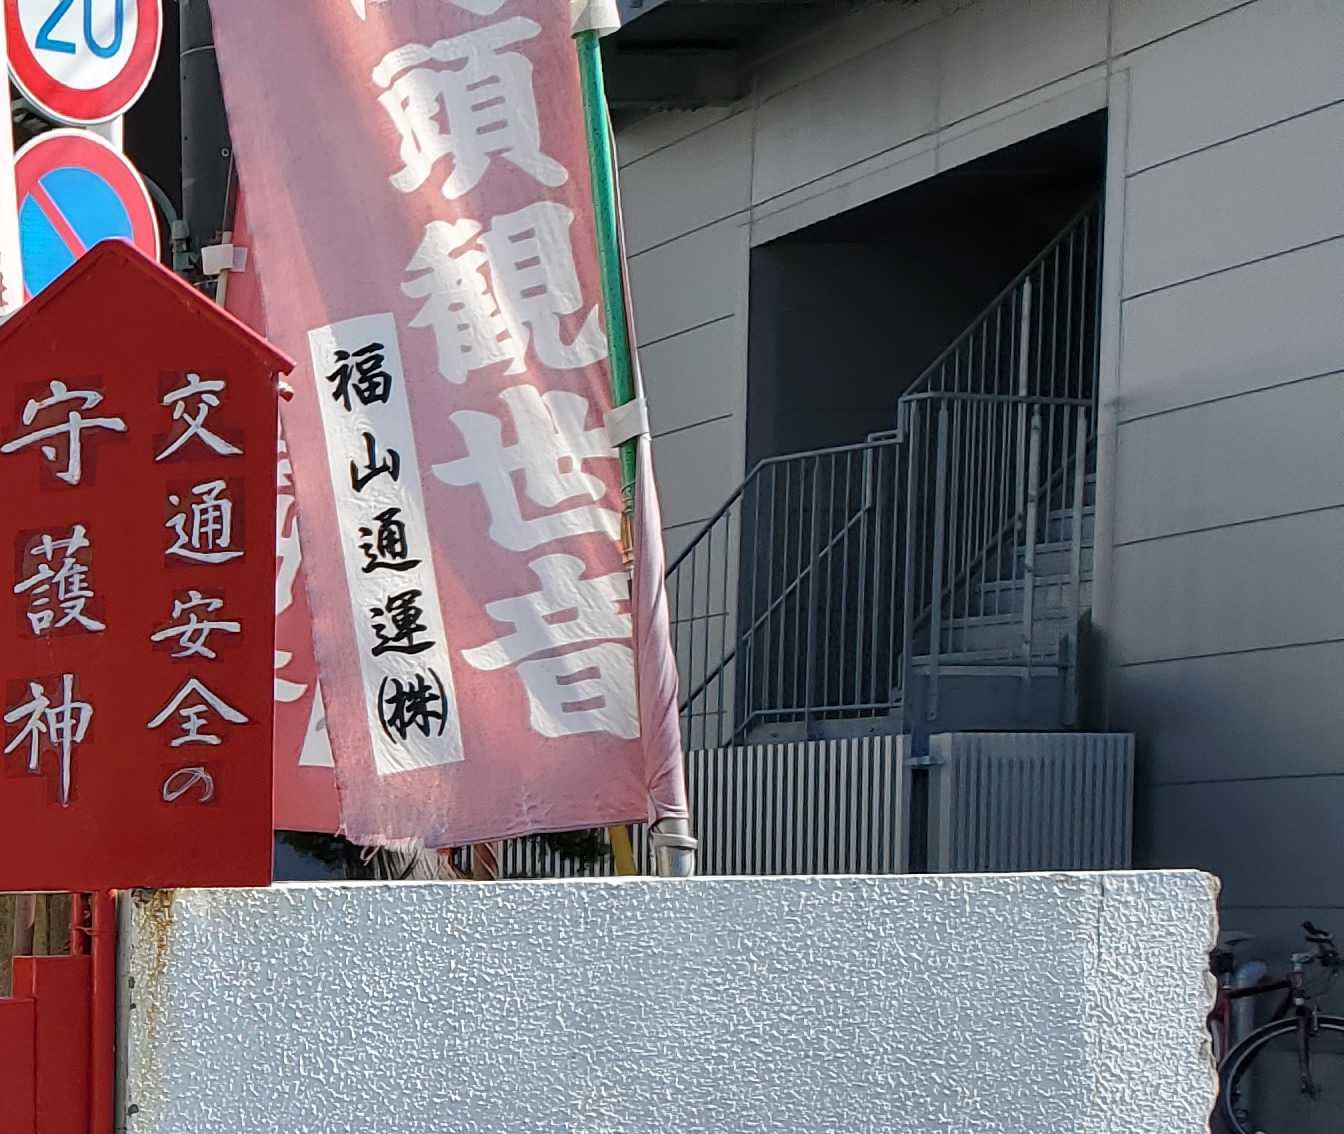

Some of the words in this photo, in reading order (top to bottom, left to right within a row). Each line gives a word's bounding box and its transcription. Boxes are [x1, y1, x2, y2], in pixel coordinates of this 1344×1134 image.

[349, 0, 640, 739] 頭観世音
[0, 379, 128, 808] 守護神
[146, 373, 249, 802] 交通安全の
